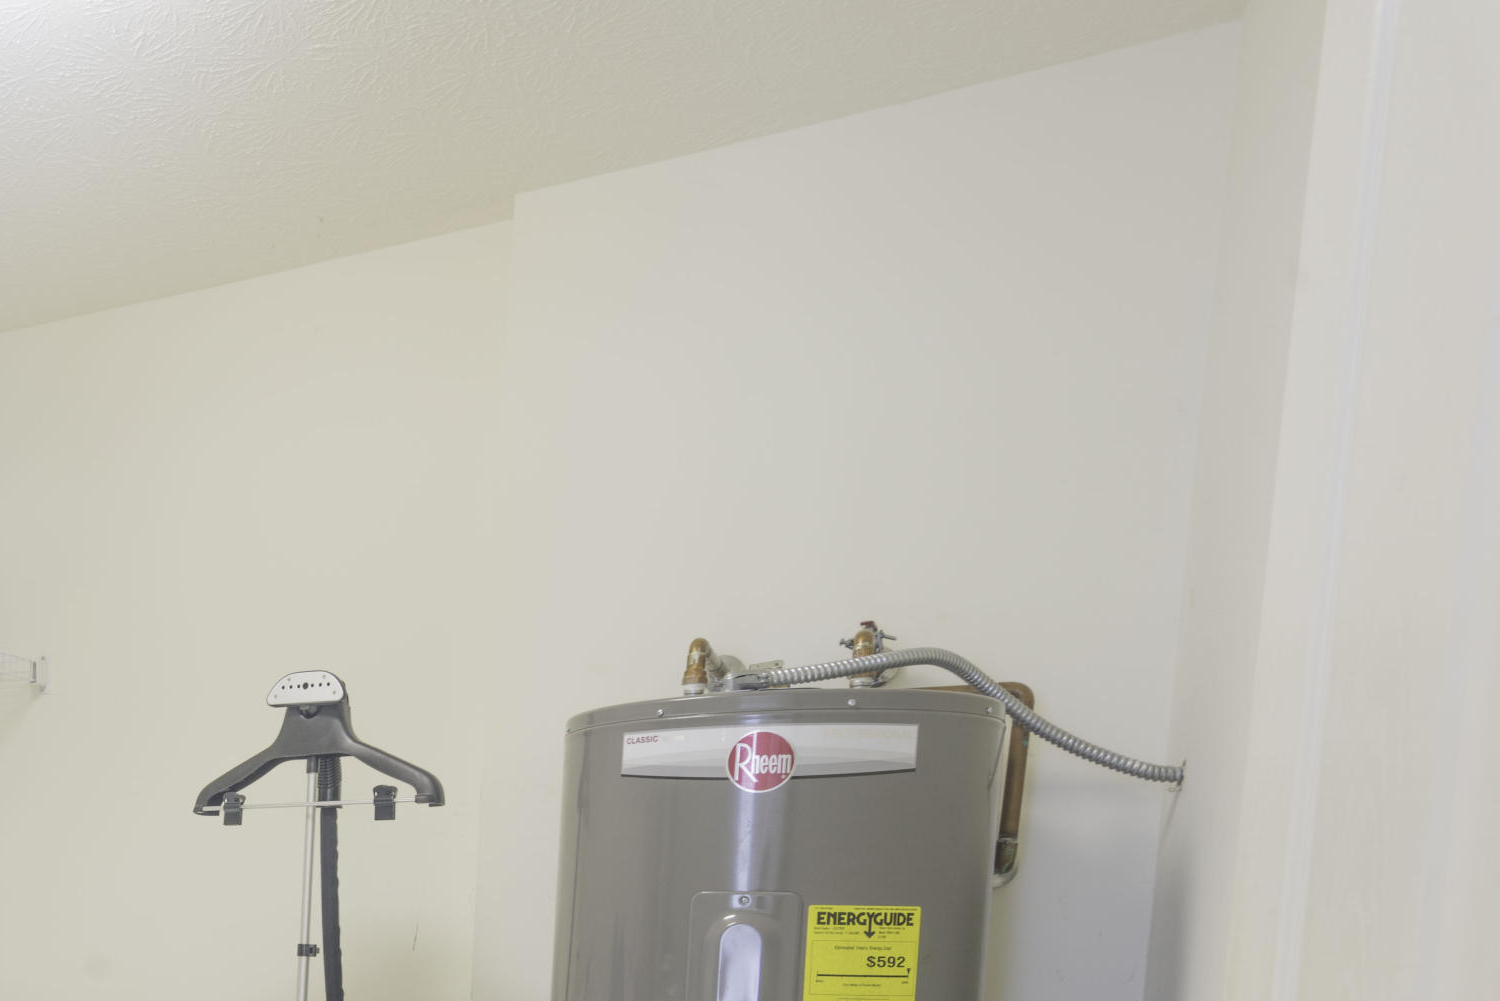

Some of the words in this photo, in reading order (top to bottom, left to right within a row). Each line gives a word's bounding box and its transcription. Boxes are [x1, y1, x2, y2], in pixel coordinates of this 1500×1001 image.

[626, 736, 659, 744] CLASSIC
[734, 731, 792, 783] Rheem
[816, 911, 915, 927] ENERGYGUIDE
[866, 955, 906, 968] $592
